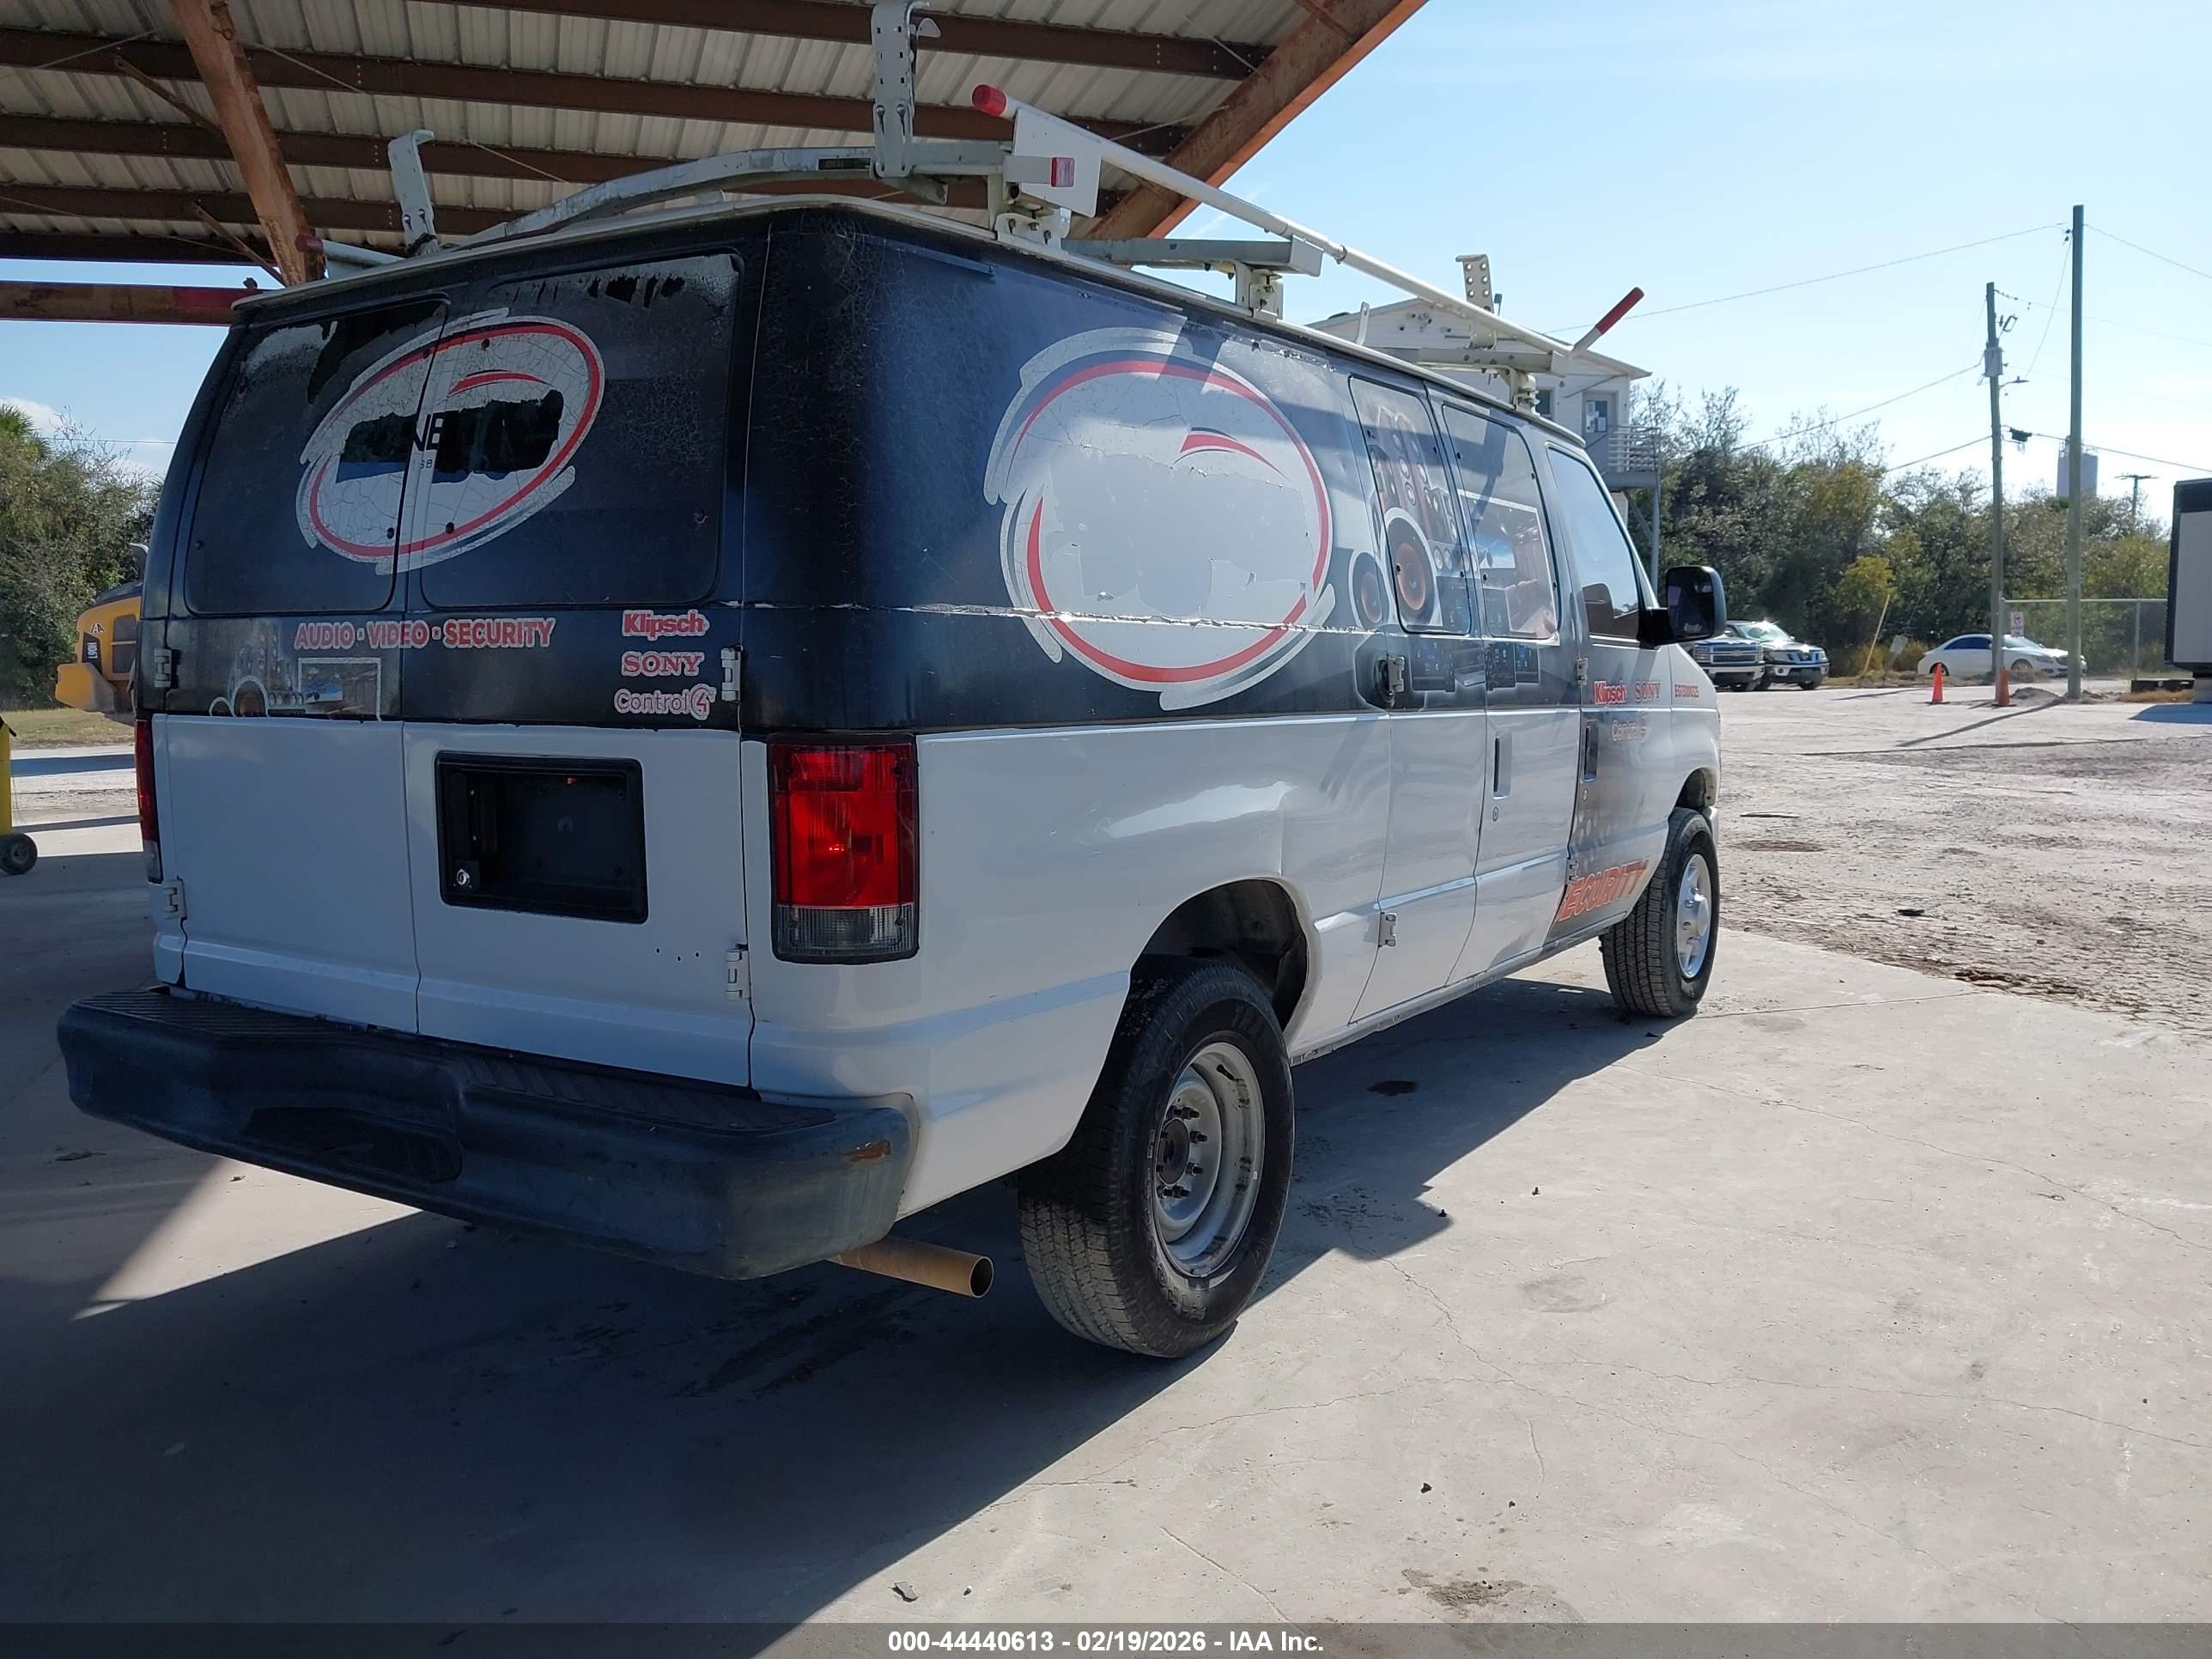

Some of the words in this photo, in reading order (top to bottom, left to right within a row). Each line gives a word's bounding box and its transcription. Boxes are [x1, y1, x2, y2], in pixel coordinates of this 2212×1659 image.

[295, 622, 355, 648] AUDIO
[367, 621, 428, 647] VIDEO
[443, 618, 555, 647] SECURITY
[623, 611, 707, 640] Klipsch
[623, 653, 703, 675] SONY
[615, 685, 714, 720] Control4
[1595, 681, 1627, 705] Klipsch
[1634, 681, 1661, 702] SONY
[1556, 860, 1649, 921] ECURITY
